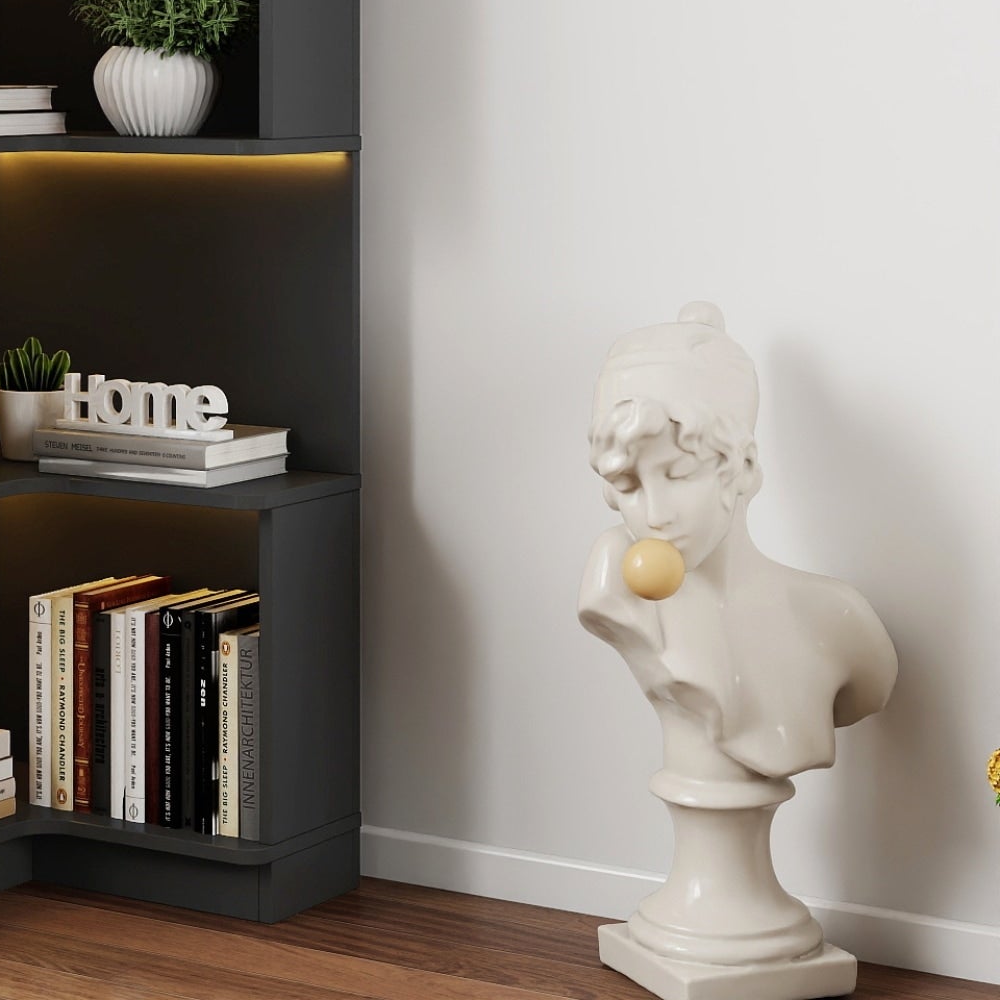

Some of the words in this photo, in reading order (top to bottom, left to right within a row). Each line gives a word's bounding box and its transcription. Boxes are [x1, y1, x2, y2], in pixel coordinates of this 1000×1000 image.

[64, 372, 229, 432] Home
[44, 440, 68, 450] STEVEN
[71, 442, 93, 452] MEISEL
[240, 648, 256, 810] INNENARCHITEKTUR
